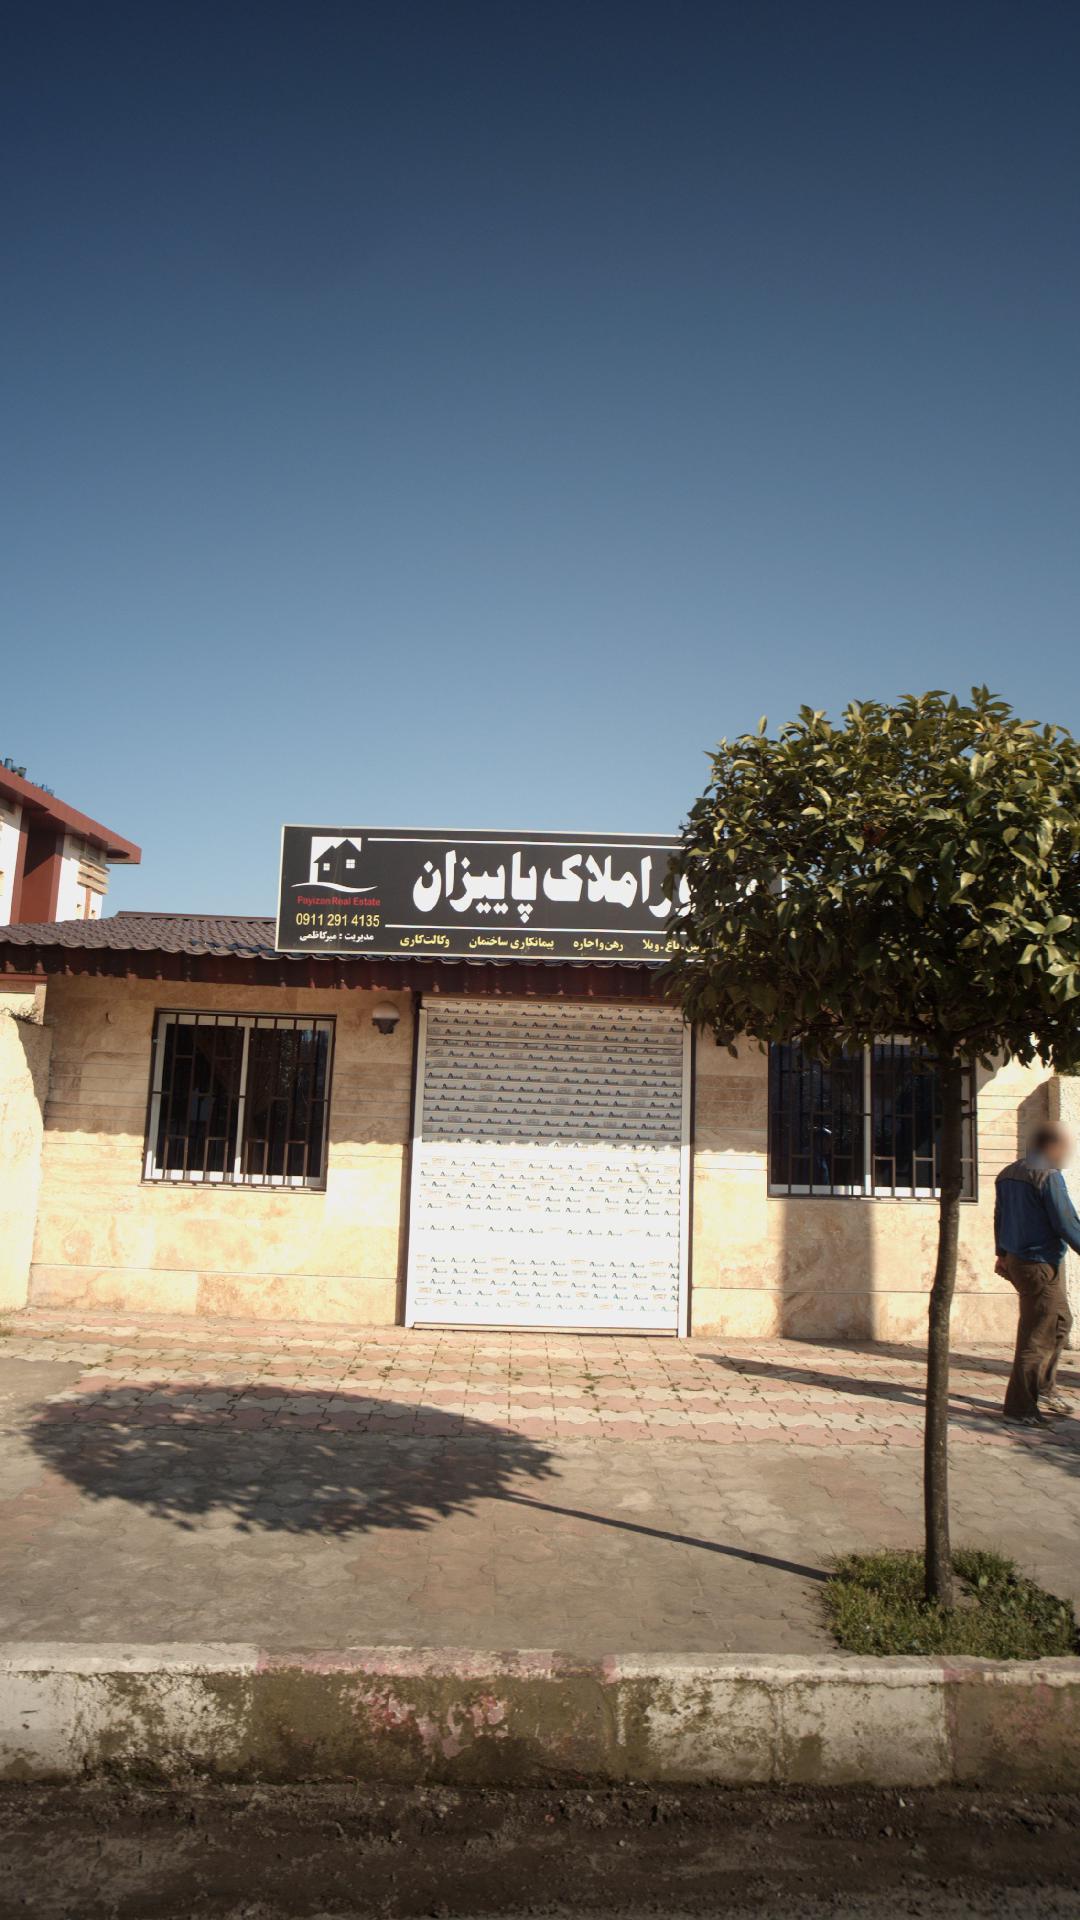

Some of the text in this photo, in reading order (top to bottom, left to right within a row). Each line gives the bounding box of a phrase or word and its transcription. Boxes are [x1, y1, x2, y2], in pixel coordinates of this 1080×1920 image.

[412, 849, 537, 924] پاییزان
[543, 853, 653, 908] املاک
[332, 896, 351, 906] Real
[353, 897, 381, 906] Estate
[296, 912, 380, 928] 0911 291 4135
[299, 930, 337, 942] میرکاظمی
[344, 933, 375, 943] مدیریت
[468, 935, 508, 948] ساختمان
[510, 936, 555, 951] پیمانکاری
